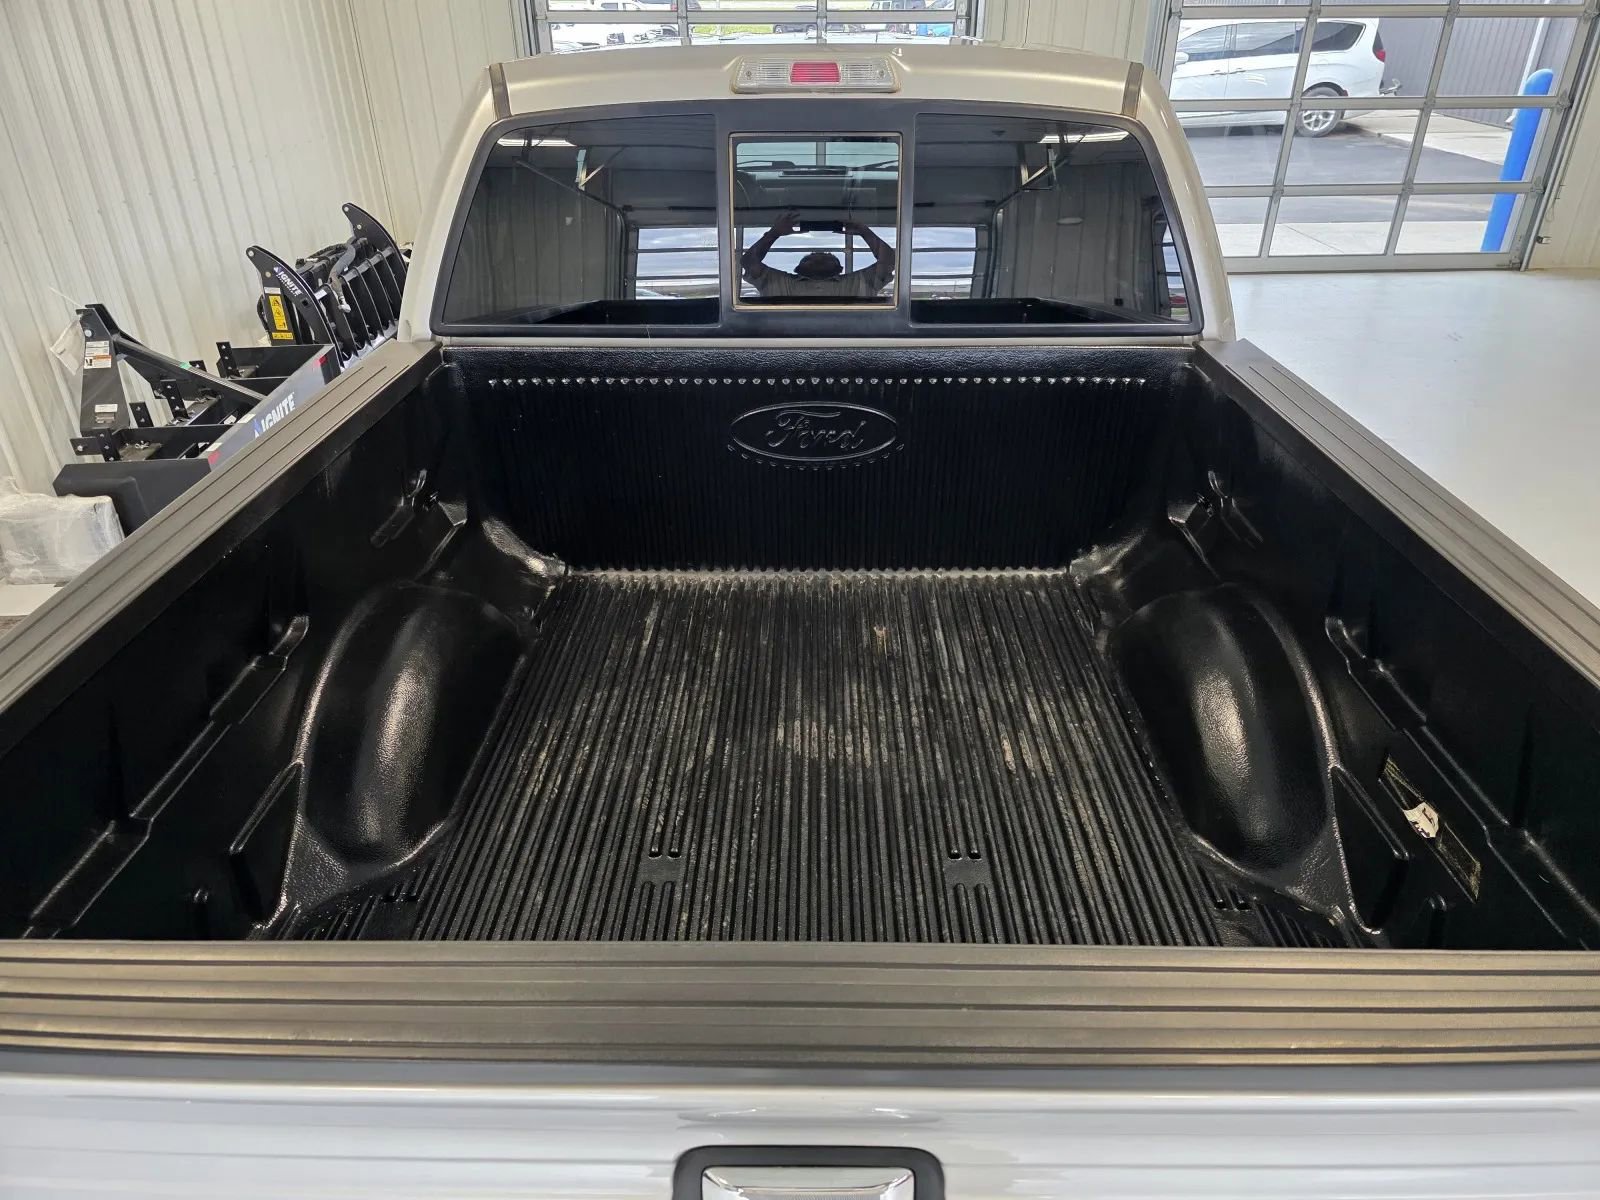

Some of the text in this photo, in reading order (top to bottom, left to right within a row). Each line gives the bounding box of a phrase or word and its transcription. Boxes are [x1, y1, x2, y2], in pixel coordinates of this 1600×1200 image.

[278, 271, 302, 296] IGNITE
[260, 394, 296, 432] IGNITE
[766, 410, 866, 449] Ford
